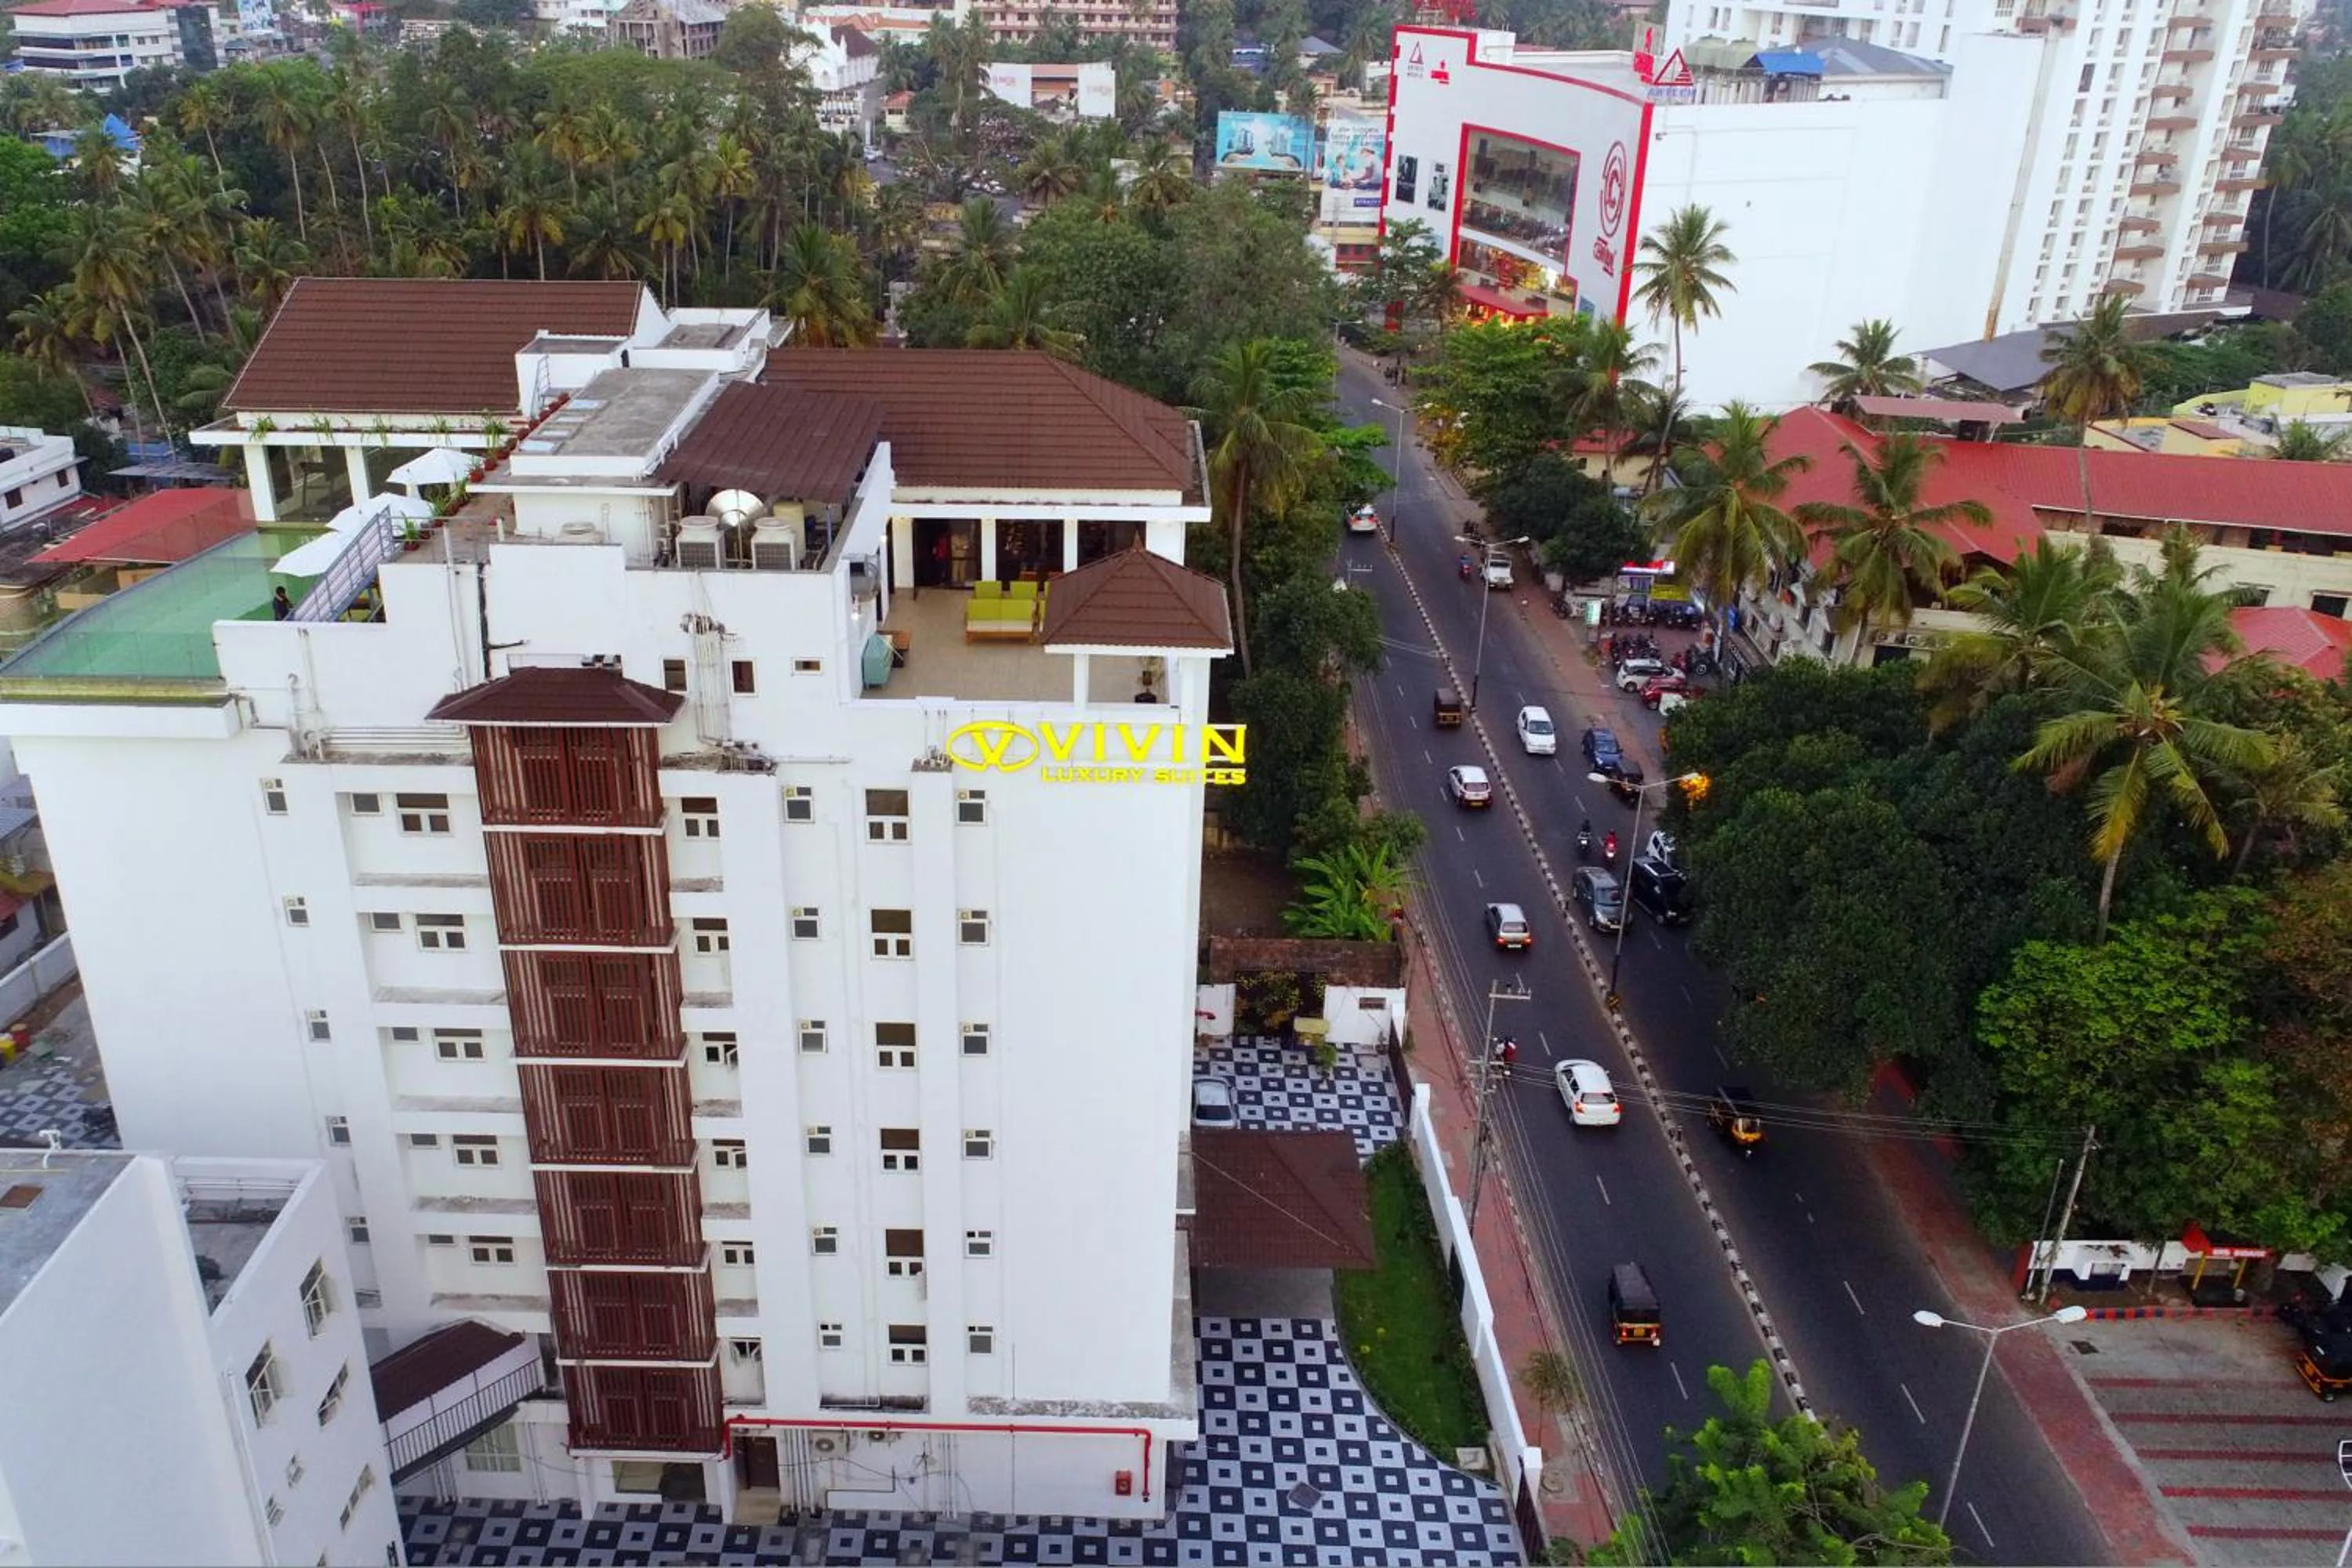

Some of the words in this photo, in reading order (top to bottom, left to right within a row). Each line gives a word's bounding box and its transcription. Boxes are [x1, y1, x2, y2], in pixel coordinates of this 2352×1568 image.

[1038, 723, 1247, 764] VIVIN
[1042, 767, 1144, 783] LUXURY
[1155, 768, 1247, 785] SUITES
